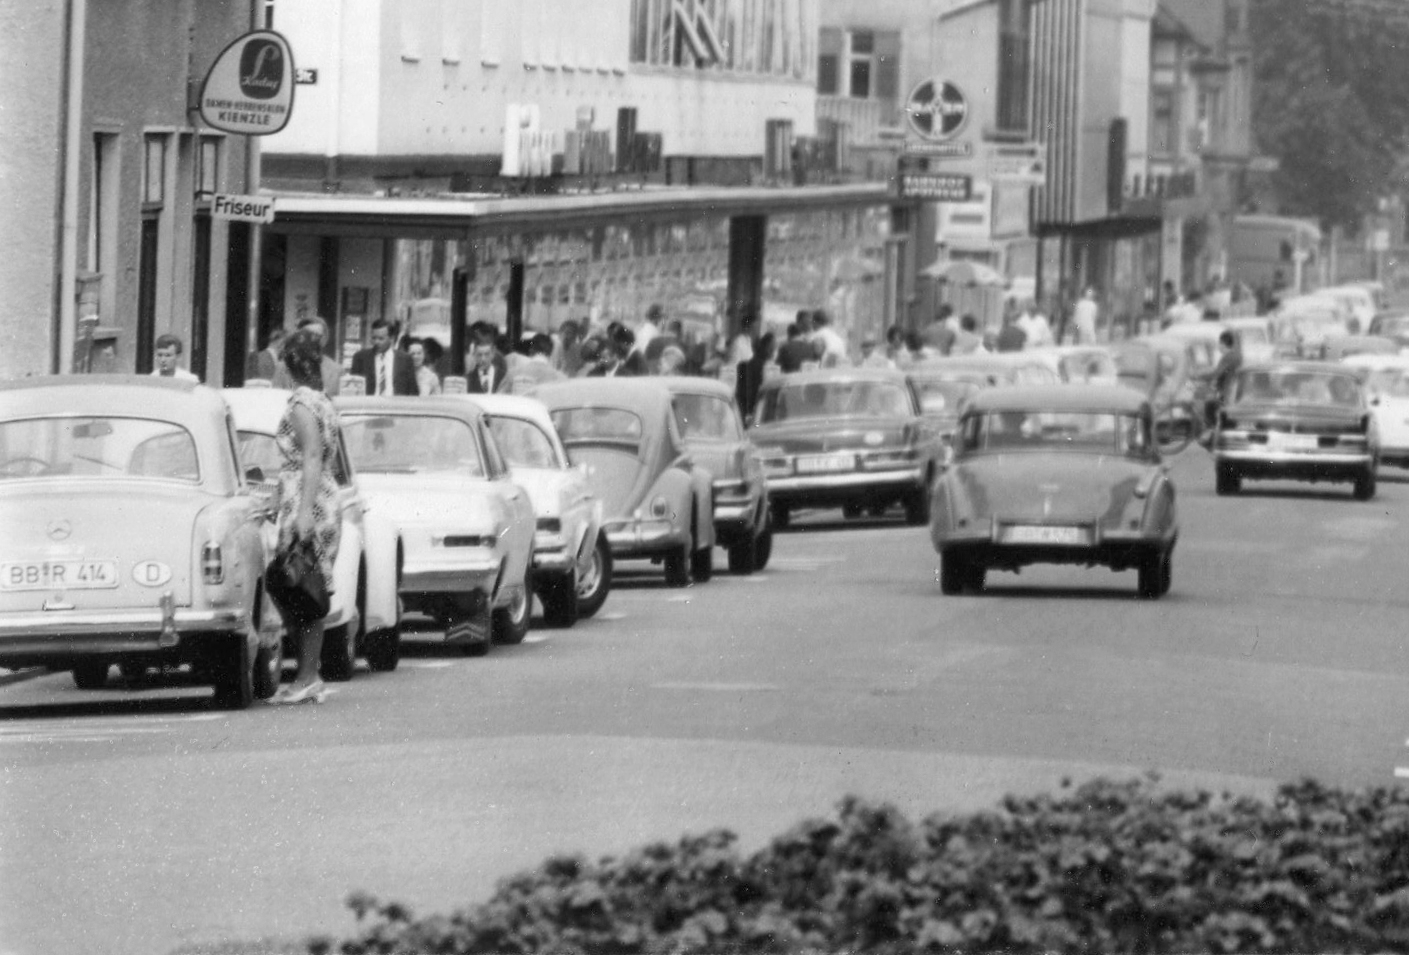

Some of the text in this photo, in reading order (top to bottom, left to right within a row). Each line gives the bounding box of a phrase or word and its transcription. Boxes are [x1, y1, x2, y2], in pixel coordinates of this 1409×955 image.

[218, 111, 271, 126] KIENZLE
[214, 196, 271, 218] Friseur
[10, 565, 40, 585] BB
[77, 563, 107, 582] 414
[145, 563, 161, 582] D
